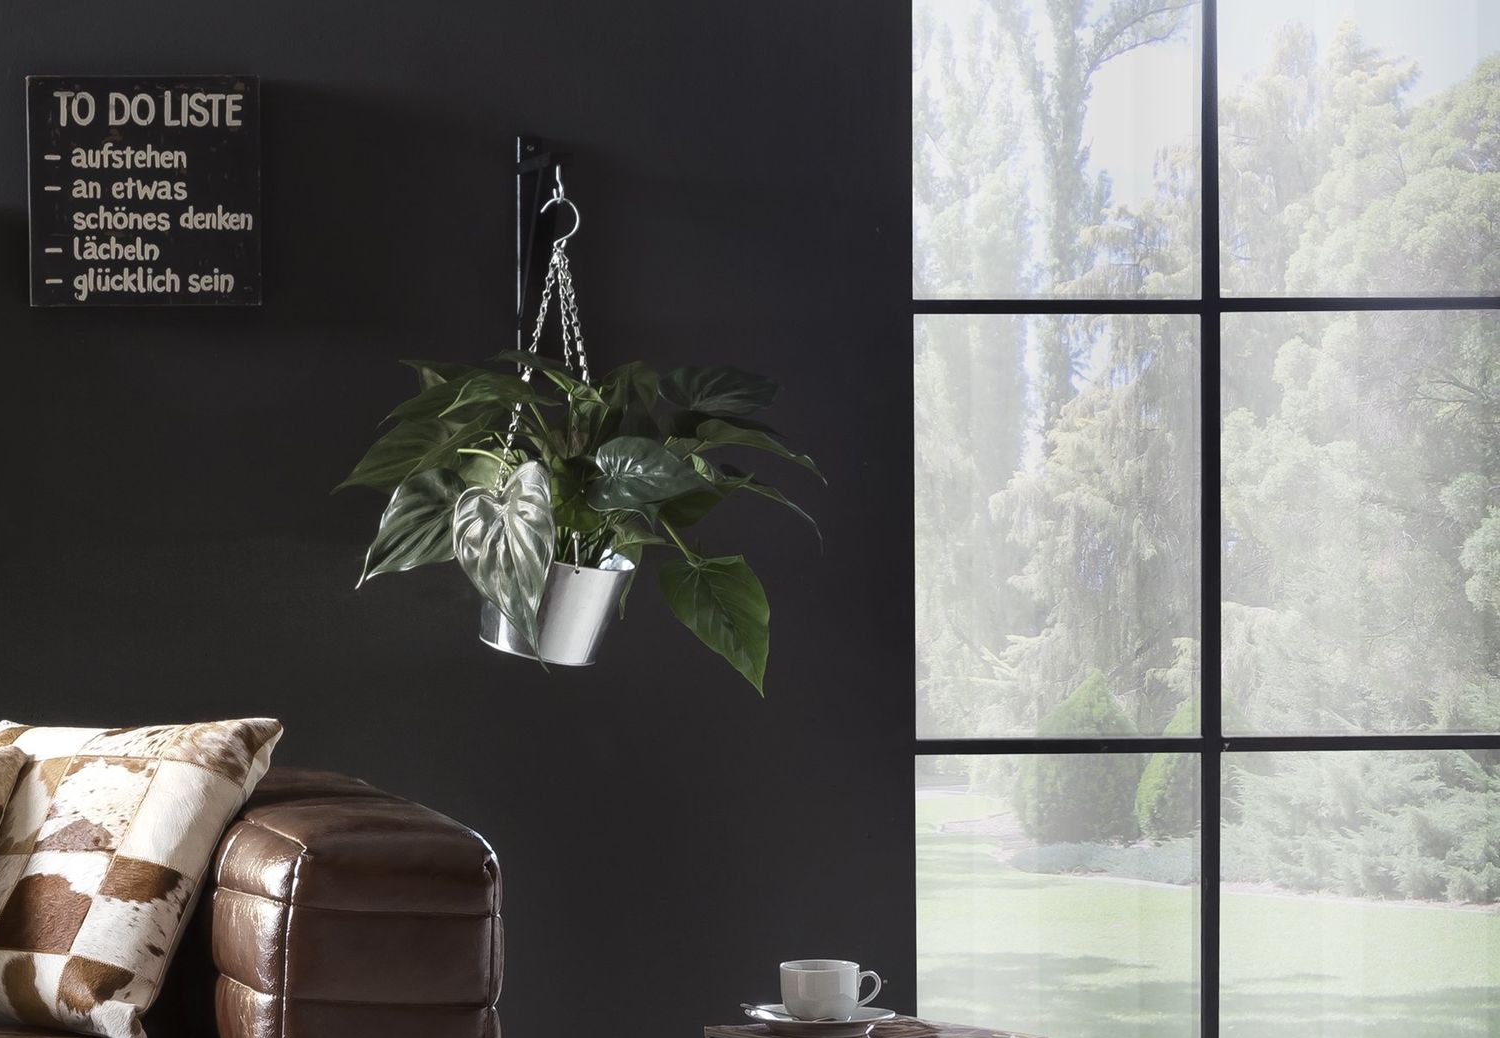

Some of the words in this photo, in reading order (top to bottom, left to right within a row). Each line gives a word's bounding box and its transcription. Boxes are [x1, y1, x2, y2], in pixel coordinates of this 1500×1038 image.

[53, 91, 96, 127] TO
[108, 92, 156, 127] DO
[164, 90, 244, 128] LISTE
[71, 142, 188, 169] aufstehen
[71, 179, 101, 199] an
[111, 177, 188, 200] etwas
[73, 205, 171, 231] schönes
[179, 204, 253, 231] denken
[73, 236, 160, 261] lächeln
[73, 266, 181, 301] glücklich
[188, 267, 235, 293] sein
